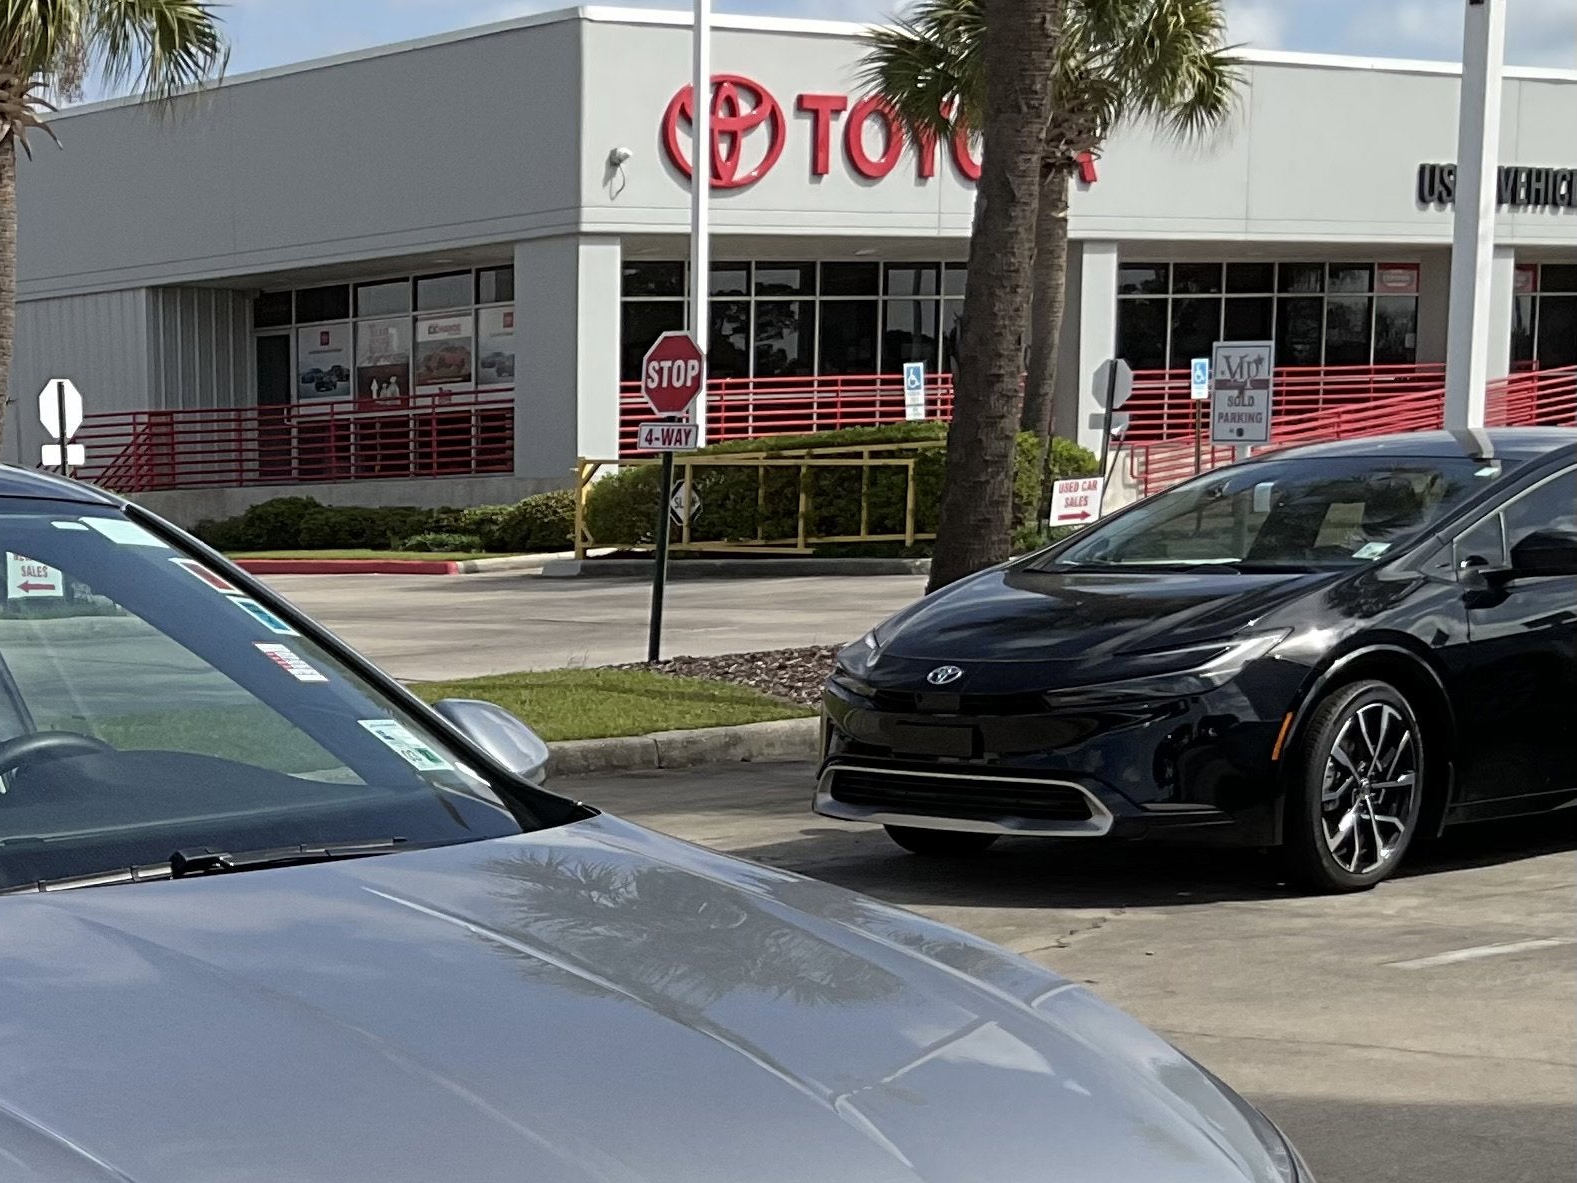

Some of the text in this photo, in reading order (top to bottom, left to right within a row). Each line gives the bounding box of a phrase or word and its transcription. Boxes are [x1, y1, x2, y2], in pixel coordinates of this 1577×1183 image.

[647, 359, 700, 389] STOP
[1227, 395, 1255, 407] SOLD
[1217, 411, 1263, 424] PARKING
[644, 428, 692, 446] 4-WAY
[1058, 480, 1098, 494] USED CAR
[1064, 495, 1089, 508] SALES
[21, 565, 48, 578] SALES
